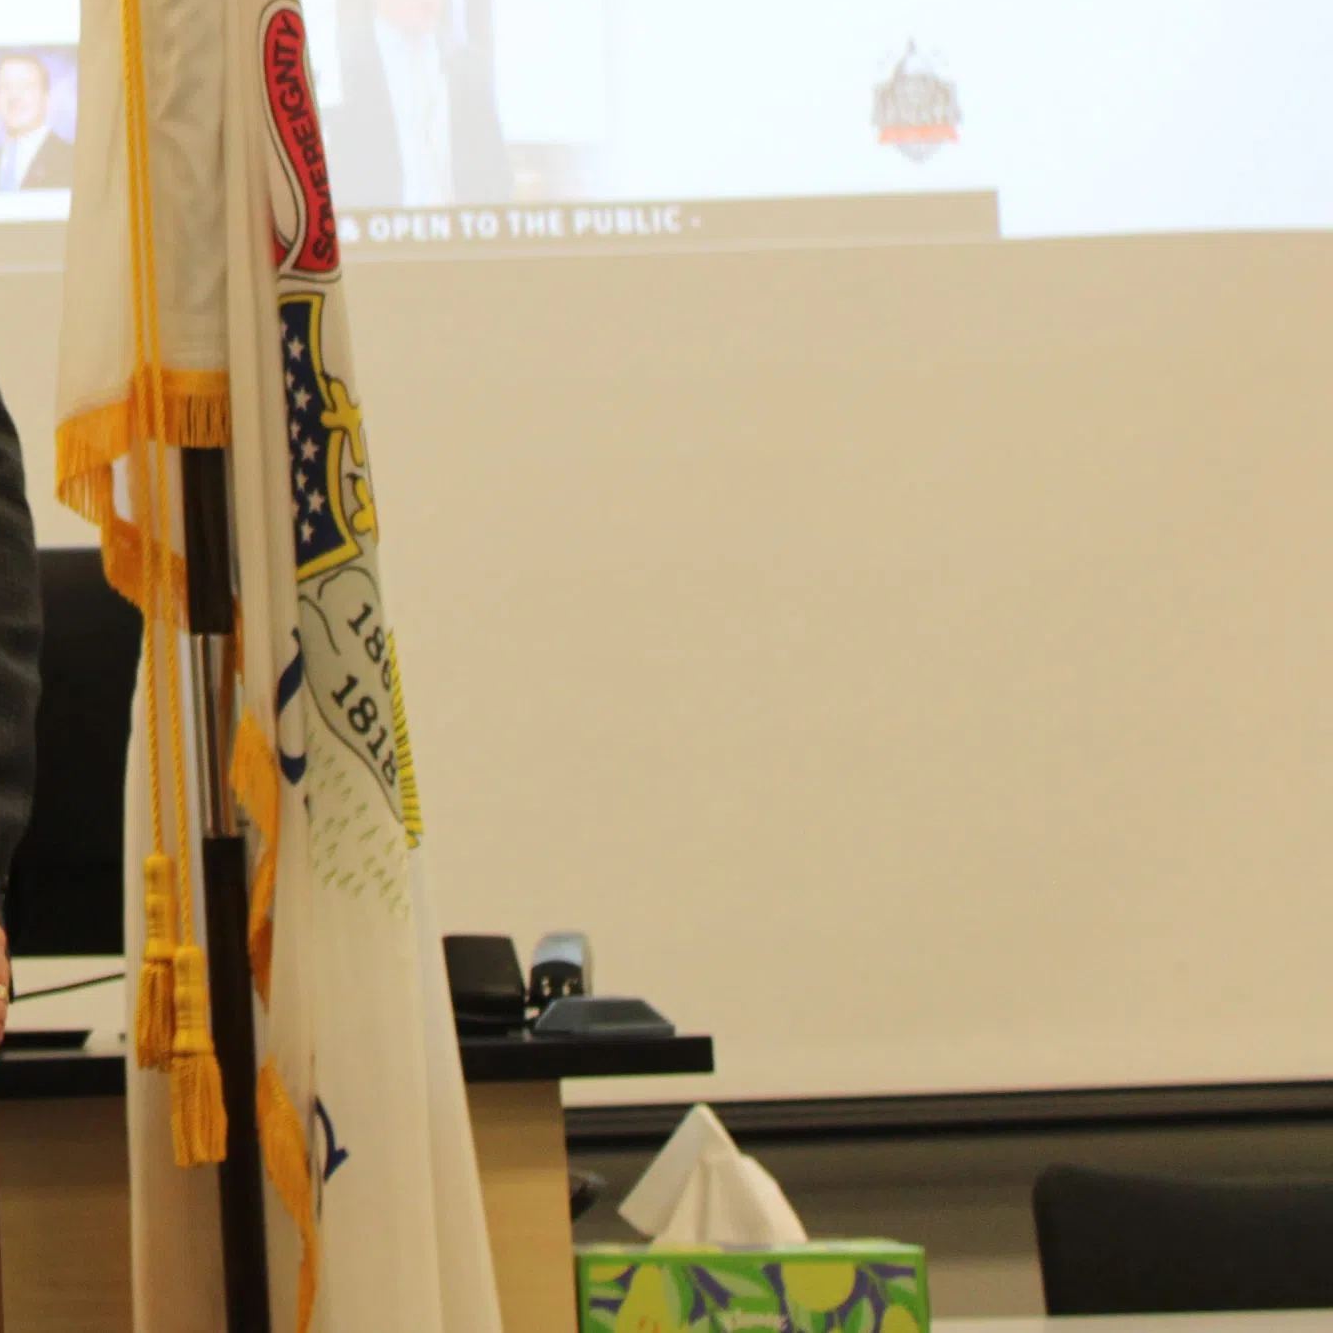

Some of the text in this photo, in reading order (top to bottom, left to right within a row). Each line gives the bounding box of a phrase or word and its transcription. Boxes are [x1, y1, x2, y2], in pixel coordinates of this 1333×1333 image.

[367, 212, 452, 242] OPEN
[459, 210, 501, 239] TO
[506, 208, 568, 237] THE
[572, 204, 683, 235] PUBLIC
